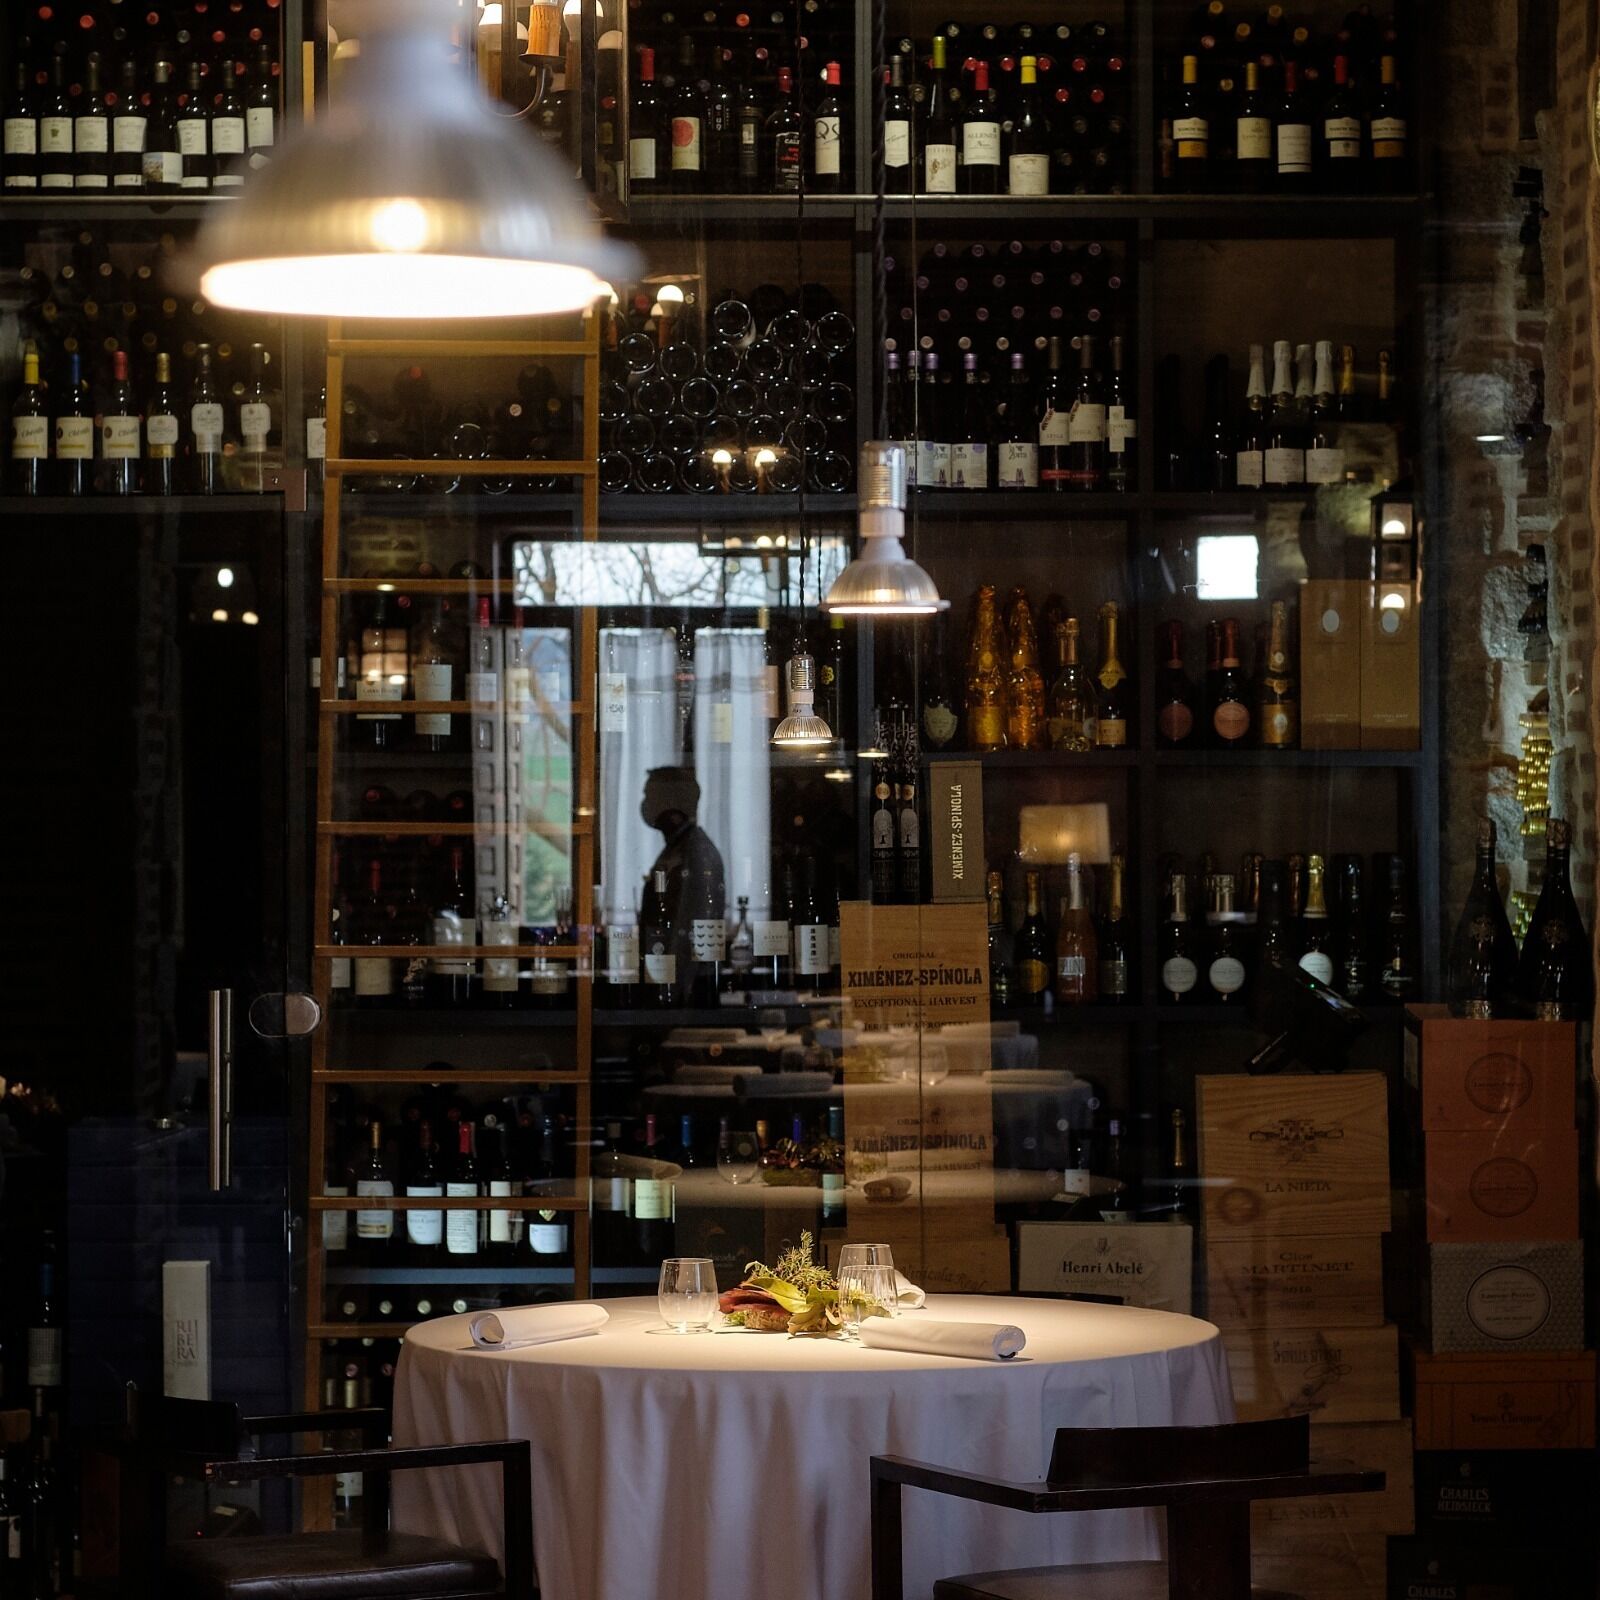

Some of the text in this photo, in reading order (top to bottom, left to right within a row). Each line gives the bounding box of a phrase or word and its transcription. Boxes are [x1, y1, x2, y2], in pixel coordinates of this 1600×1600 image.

[892, 951, 936, 960] ORIGINAL
[847, 963, 983, 988] XIMÉNEZ-SPÍNOLA
[853, 996, 978, 1009] EXCEPTIONAL HARVEST
[1265, 1181, 1332, 1193] LA NIETA
[1062, 1260, 1143, 1274] Henri Abelé
[1241, 1261, 1355, 1275] MARTINET
[1440, 1487, 1490, 1501] CHARLES
[1437, 1500, 1492, 1513] HEIDSIECK
[1407, 1584, 1457, 1600] CHARLES
